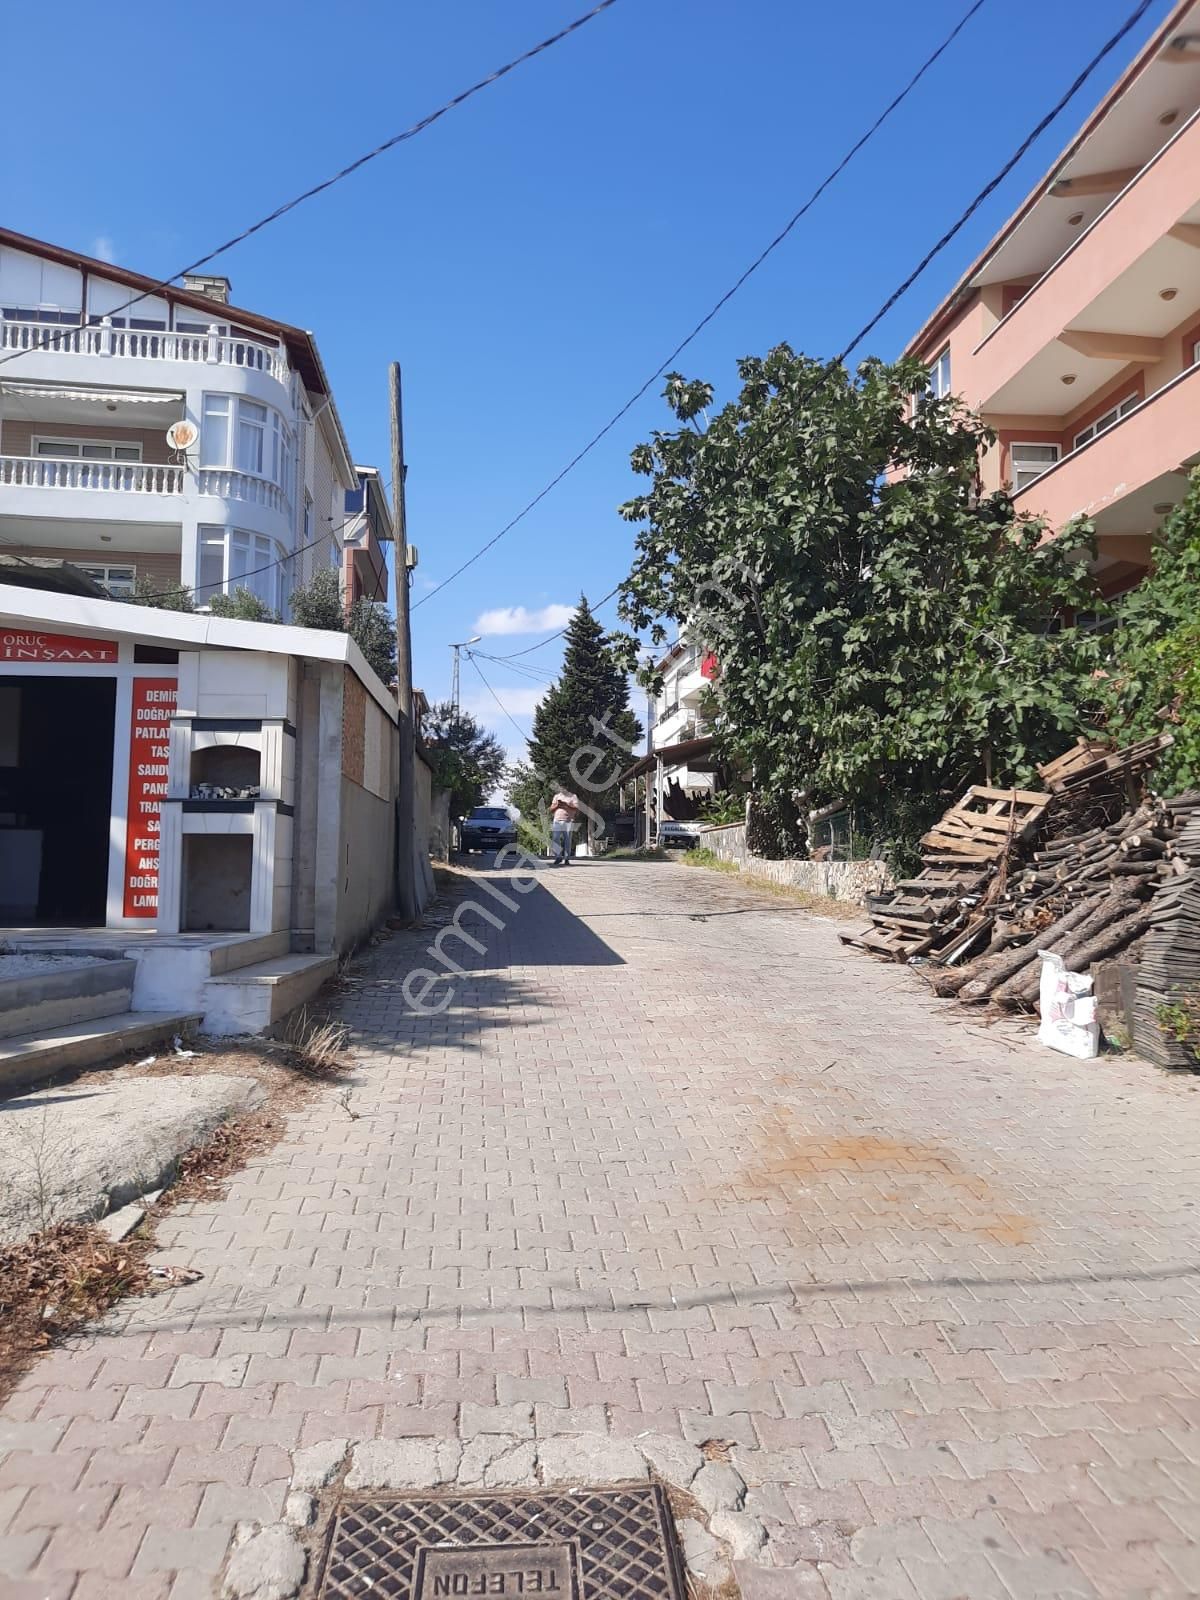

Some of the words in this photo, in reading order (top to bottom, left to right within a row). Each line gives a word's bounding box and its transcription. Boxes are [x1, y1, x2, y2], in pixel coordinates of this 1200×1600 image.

[3, 635, 47, 648] ORUÇ
[4, 646, 113, 661] İNŞAAT
[151, 745, 170, 760] TAŞ
[138, 857, 160, 871] AHŞ
[433, 1569, 561, 1597] TELEFON
